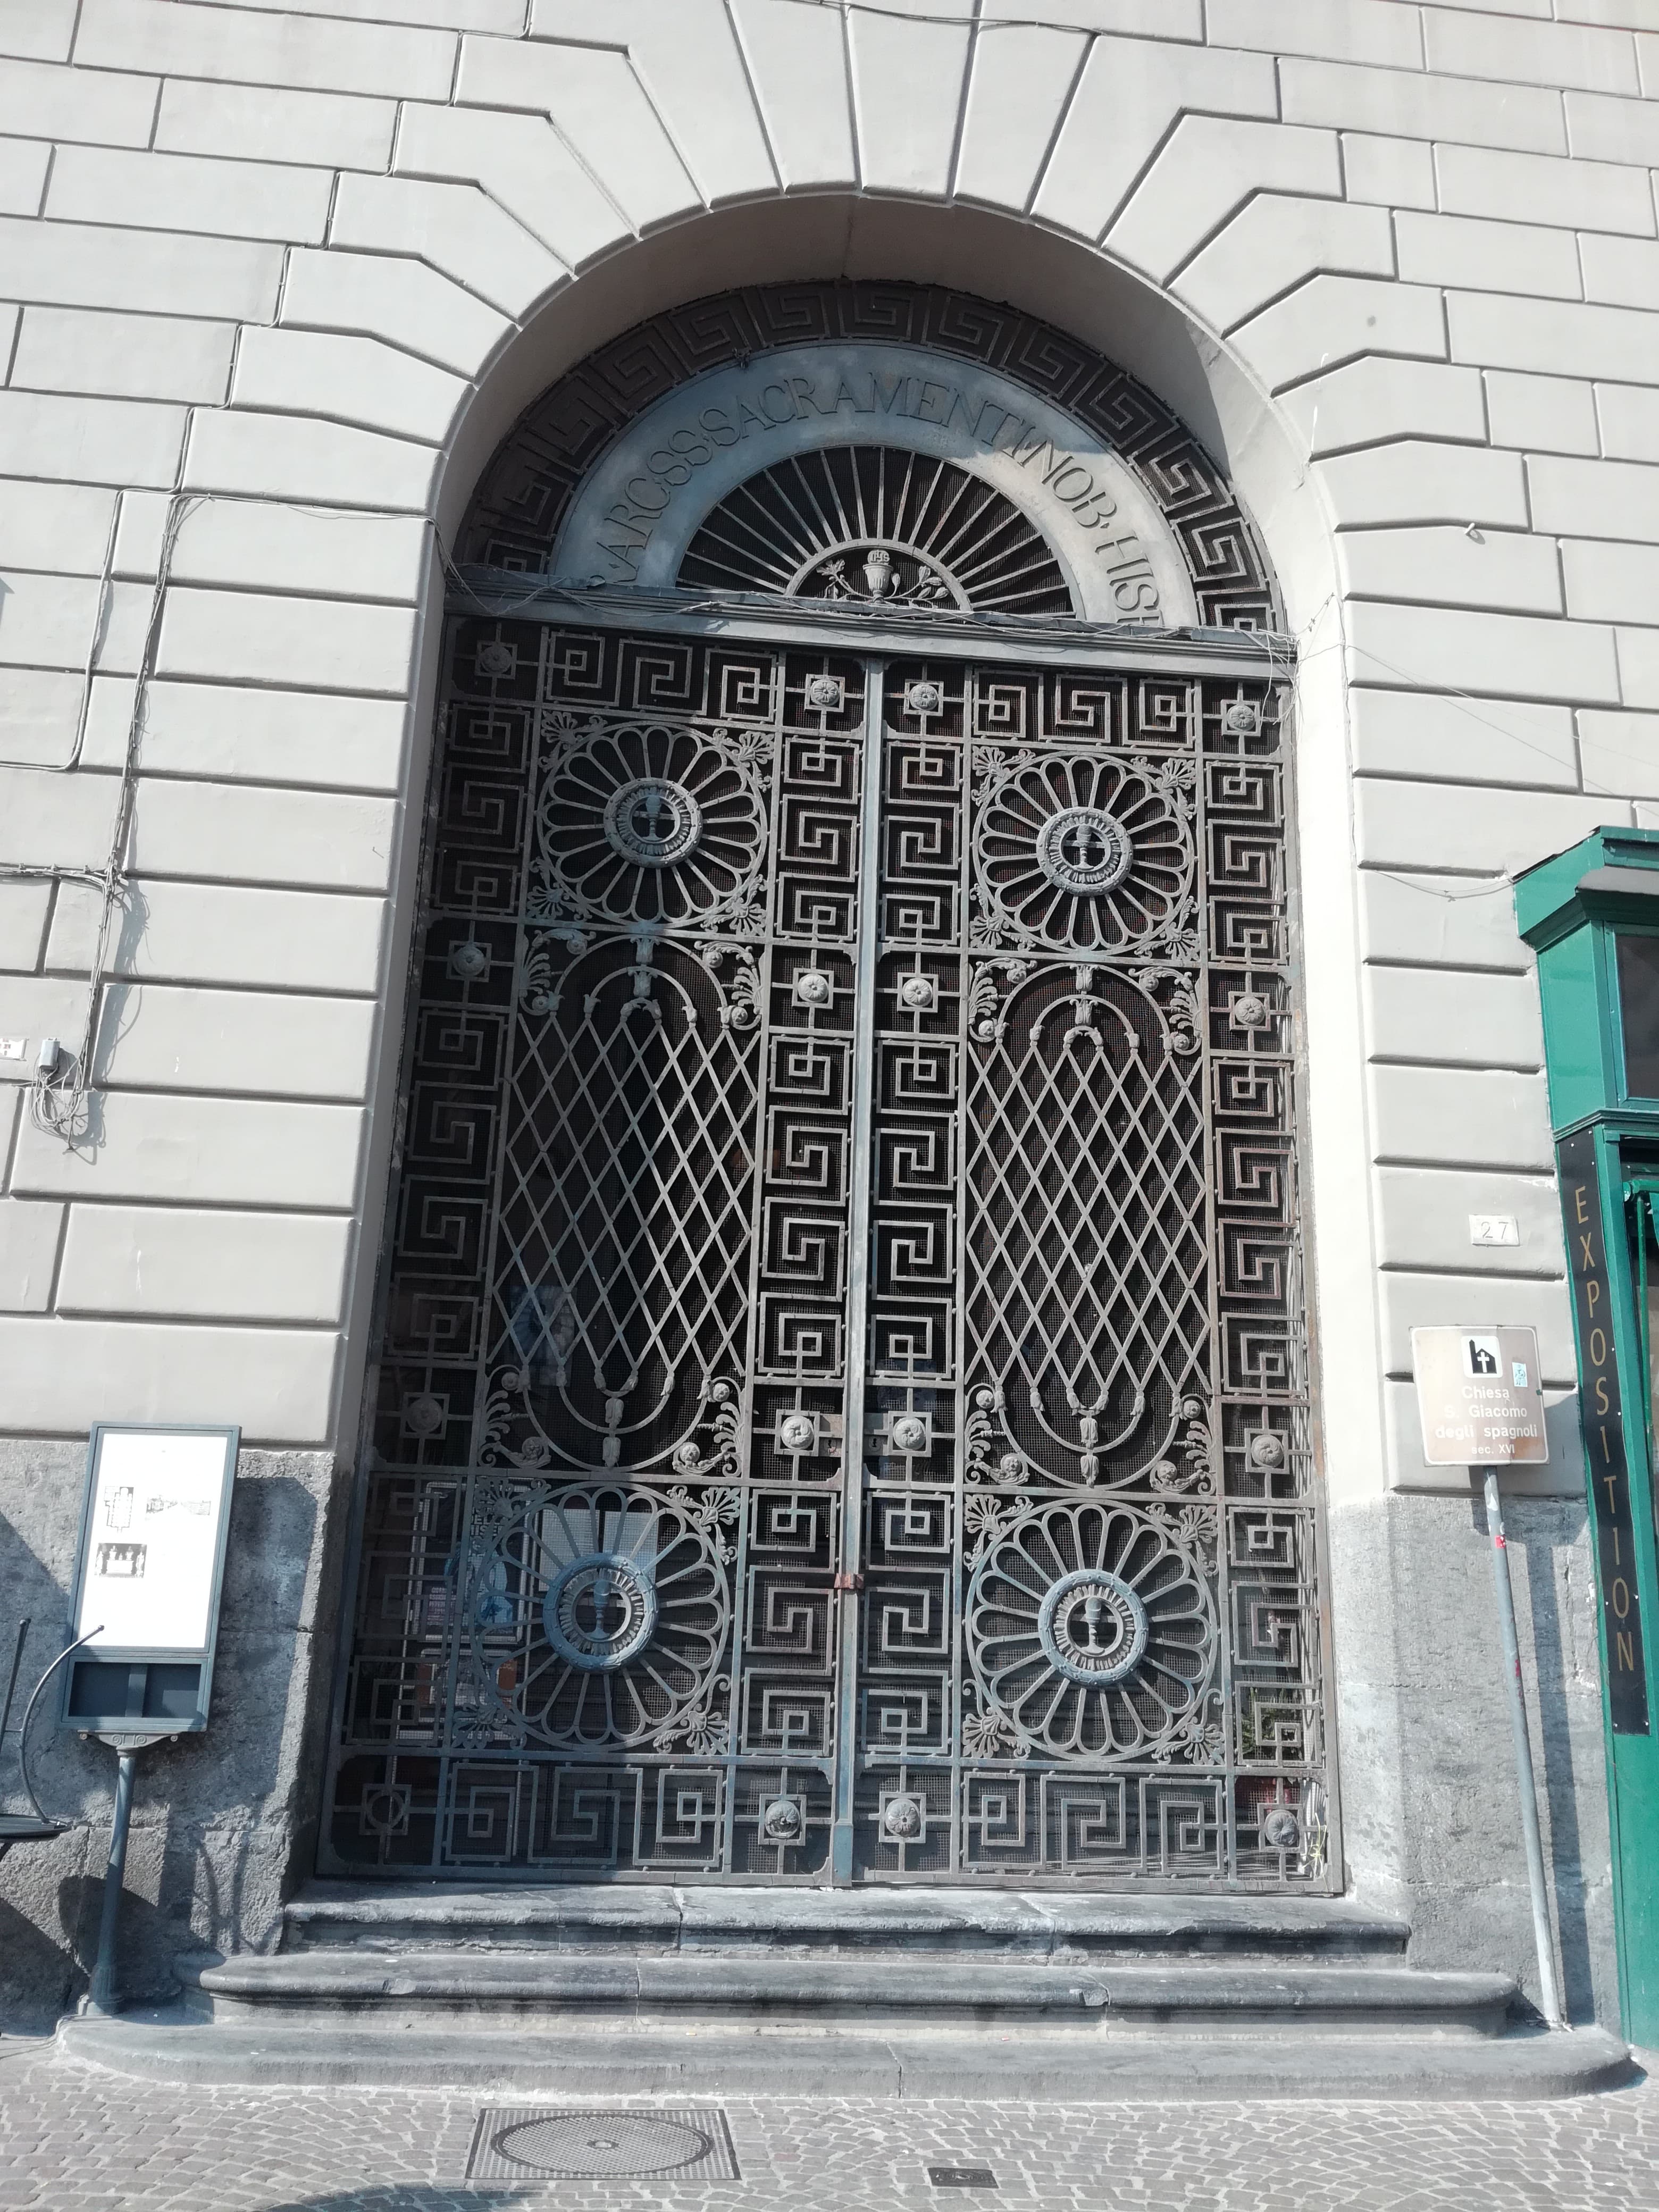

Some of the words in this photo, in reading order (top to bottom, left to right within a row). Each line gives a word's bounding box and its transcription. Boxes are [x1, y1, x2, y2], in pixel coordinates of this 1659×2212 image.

[1481, 1221, 1509, 1239] 27
[1463, 1386, 1510, 1399] Chiesa
[1445, 1405, 1459, 1419] S.
[1469, 1405, 1527, 1418] Giacomo
[1436, 1425, 1474, 1439] degli
[1484, 1424, 1537, 1439] spagnoli
[1575, 1185, 1633, 1671] EXPOSITION
[1471, 1445, 1494, 1454] sec.
[1498, 1444, 1515, 1454] XVI
